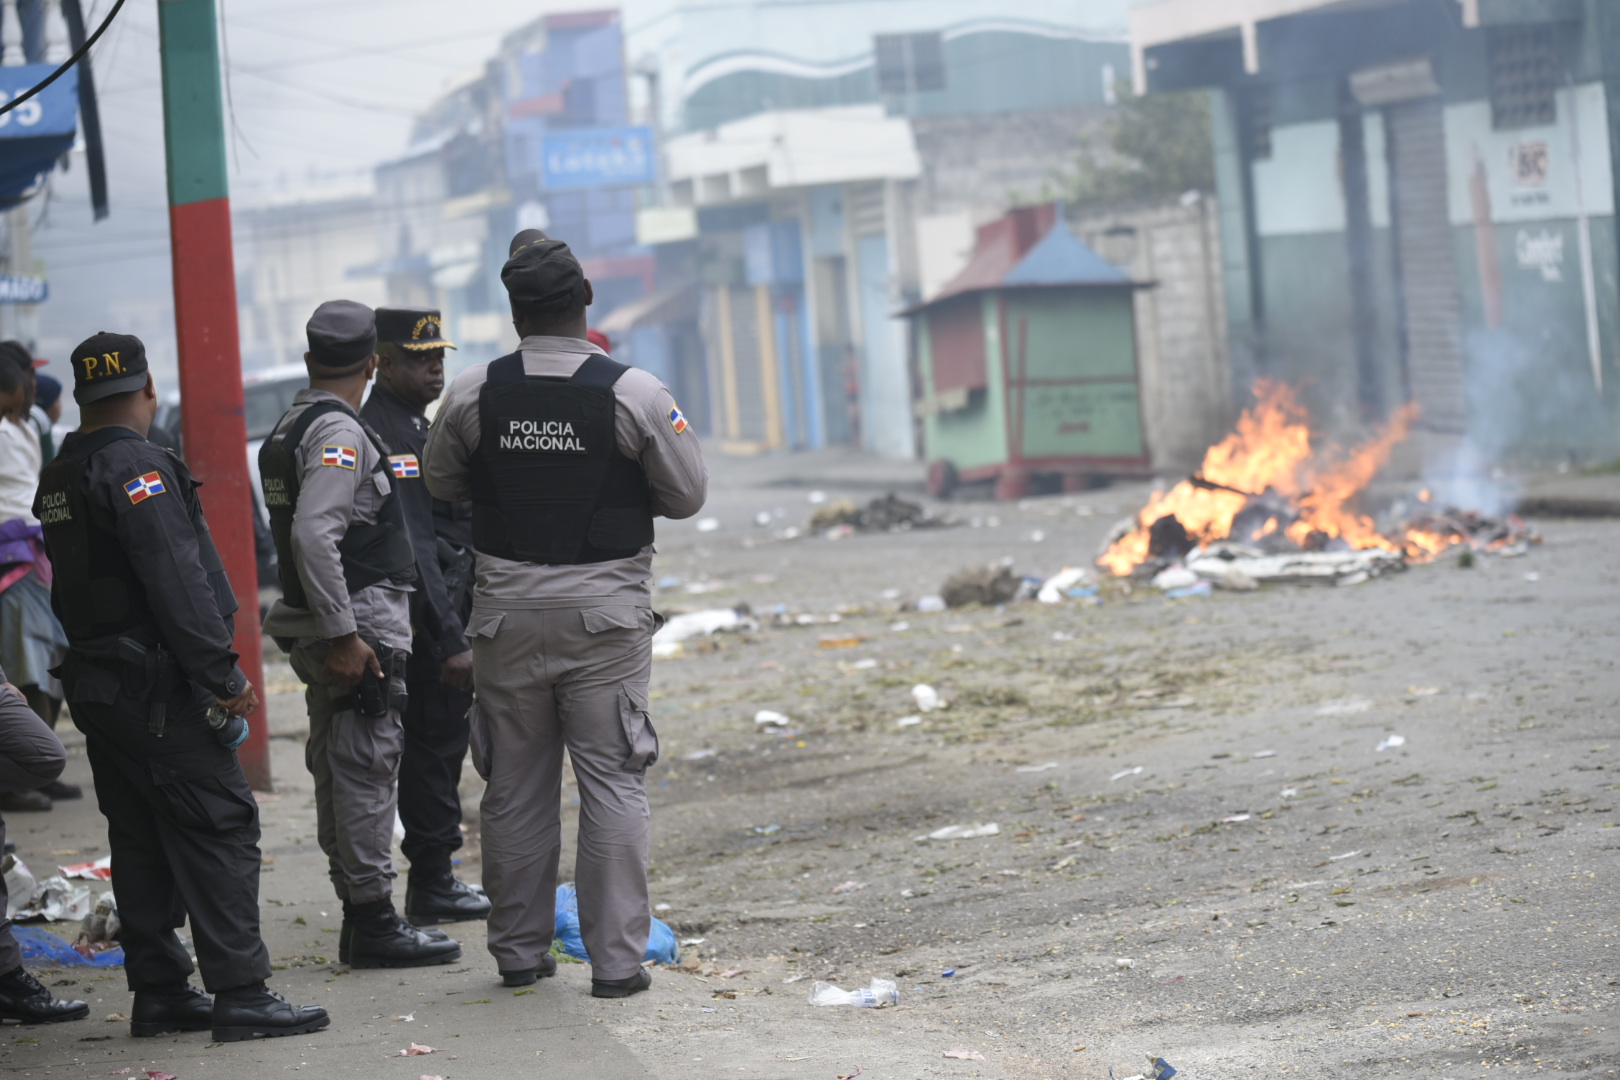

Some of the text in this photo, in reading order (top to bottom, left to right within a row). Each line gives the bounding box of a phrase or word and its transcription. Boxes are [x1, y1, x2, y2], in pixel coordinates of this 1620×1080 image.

[82, 351, 127, 380] P.N.
[509, 420, 575, 436] POLICIA
[499, 435, 586, 451] NACIONAL
[42, 491, 67, 509] POLICIA
[40, 506, 72, 525] NACIONAL
